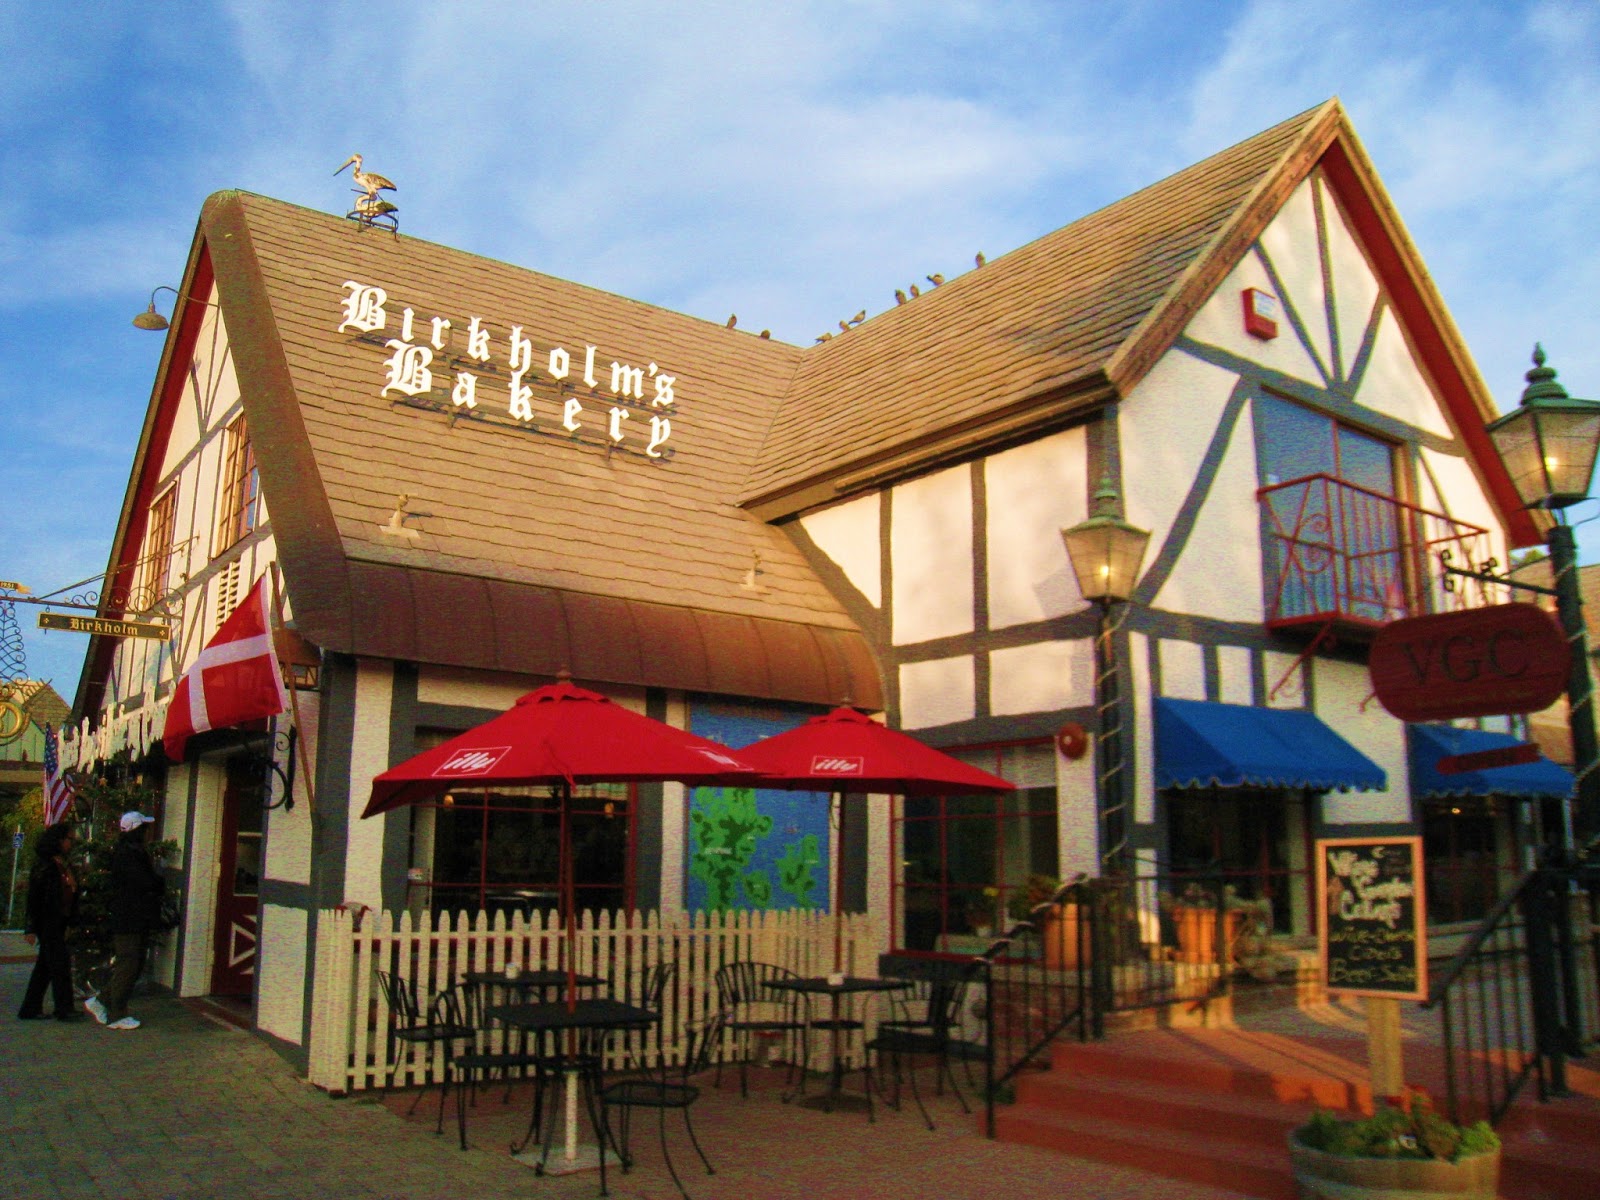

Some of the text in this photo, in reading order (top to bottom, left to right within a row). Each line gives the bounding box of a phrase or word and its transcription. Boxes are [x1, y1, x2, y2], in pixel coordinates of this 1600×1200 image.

[338, 281, 677, 408] Birkholm's
[381, 339, 672, 458] Bakery
[70, 618, 138, 636] Birkholm
[1398, 629, 1530, 686] VGC
[443, 752, 496, 773] illy
[815, 759, 858, 773] illy
